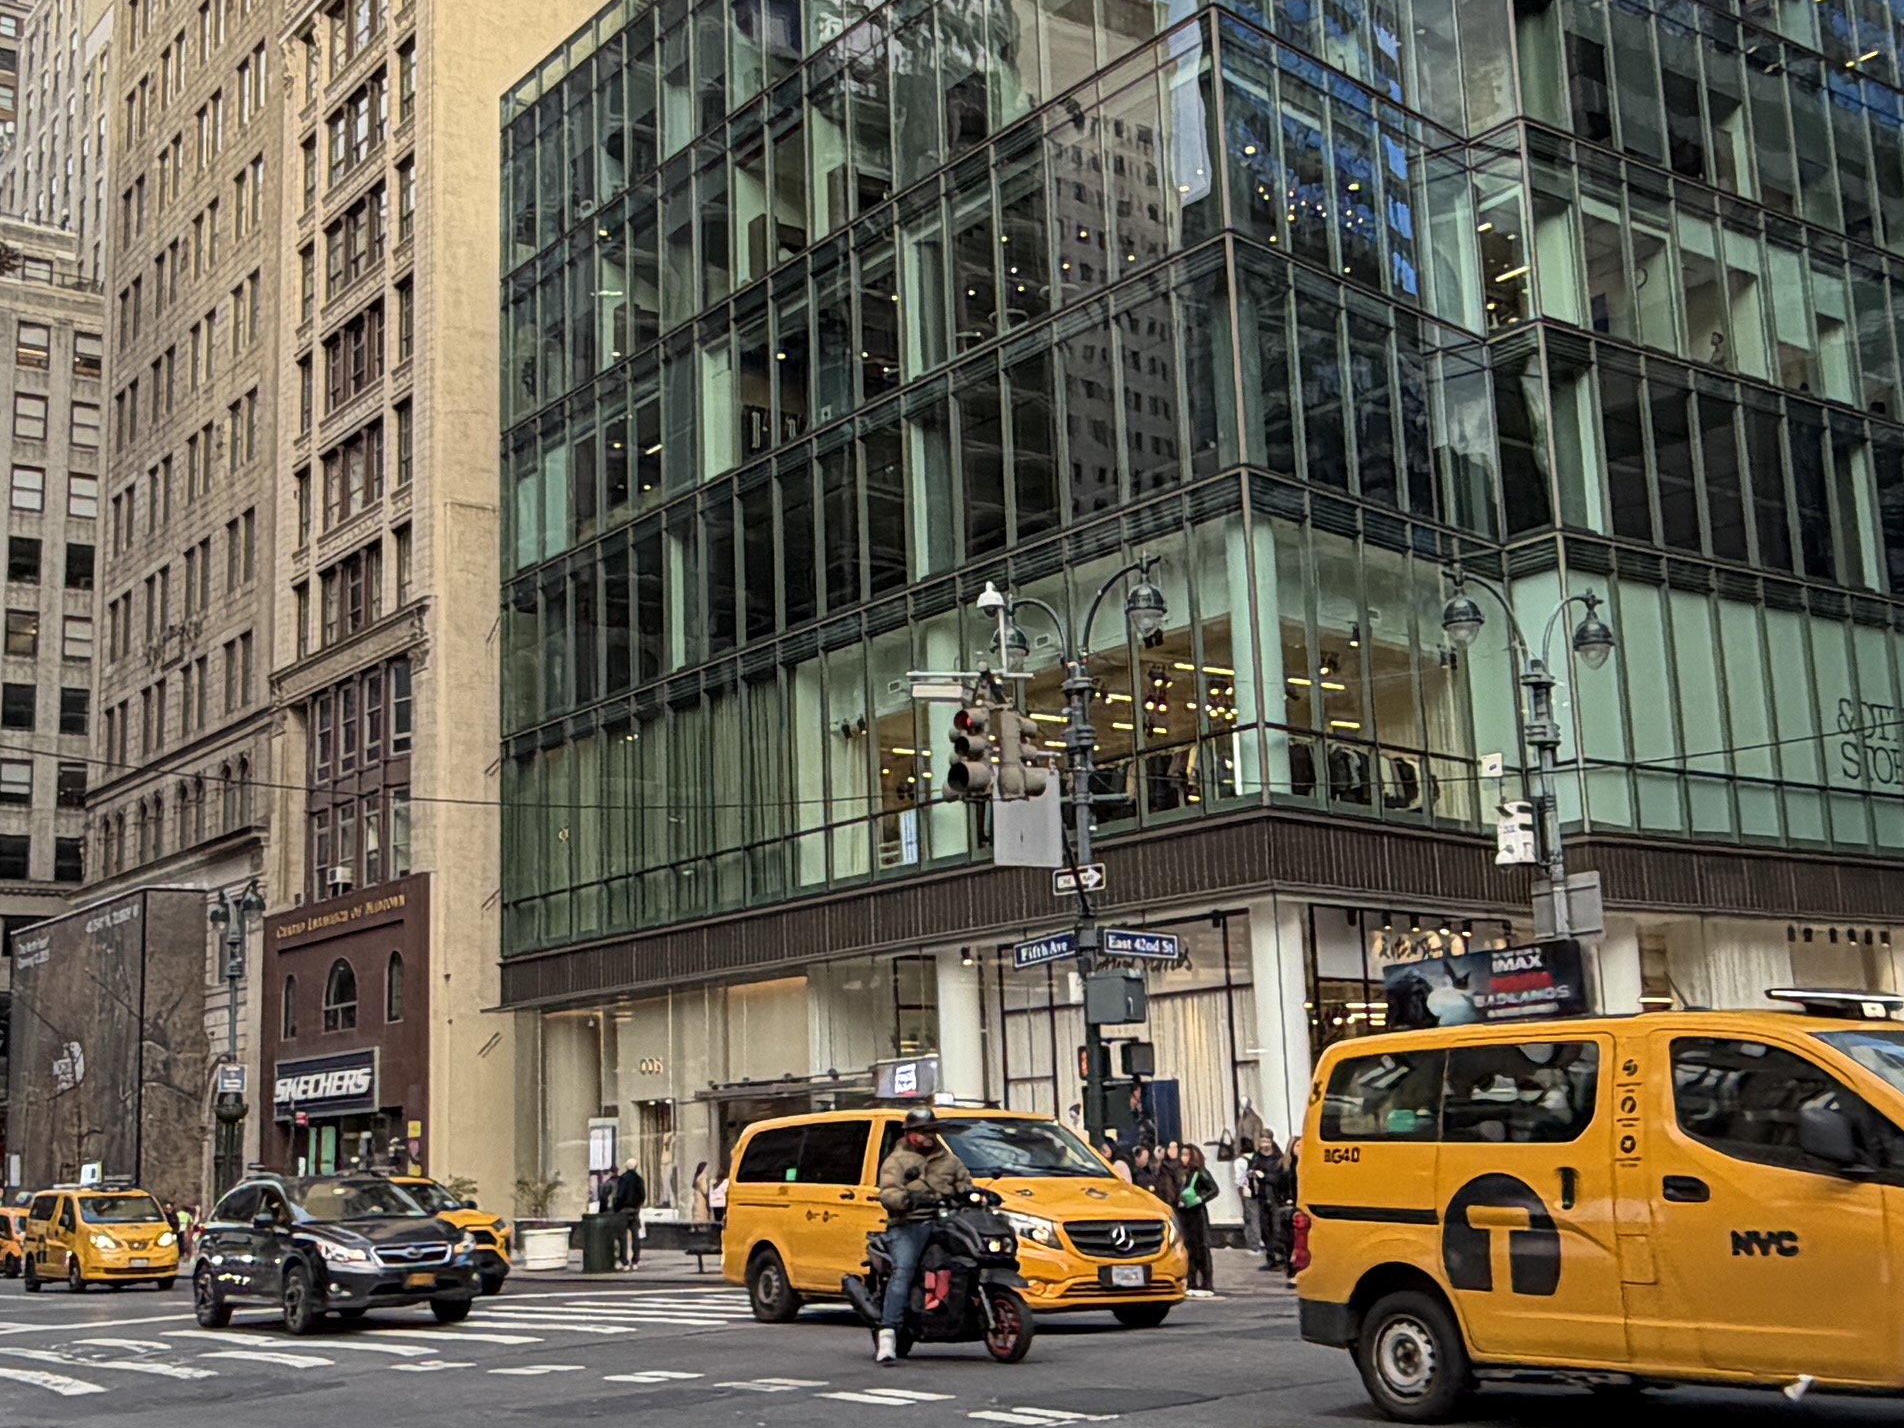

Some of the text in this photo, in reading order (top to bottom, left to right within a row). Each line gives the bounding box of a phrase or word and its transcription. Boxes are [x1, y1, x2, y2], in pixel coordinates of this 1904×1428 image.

[1020, 939, 1068, 962] Fifth Ave
[1107, 934, 1174, 954] East 42nd St
[1492, 953, 1543, 973] IMAX
[273, 1067, 372, 1104] SKECHERS
[1730, 1230, 1800, 1257] NYC
